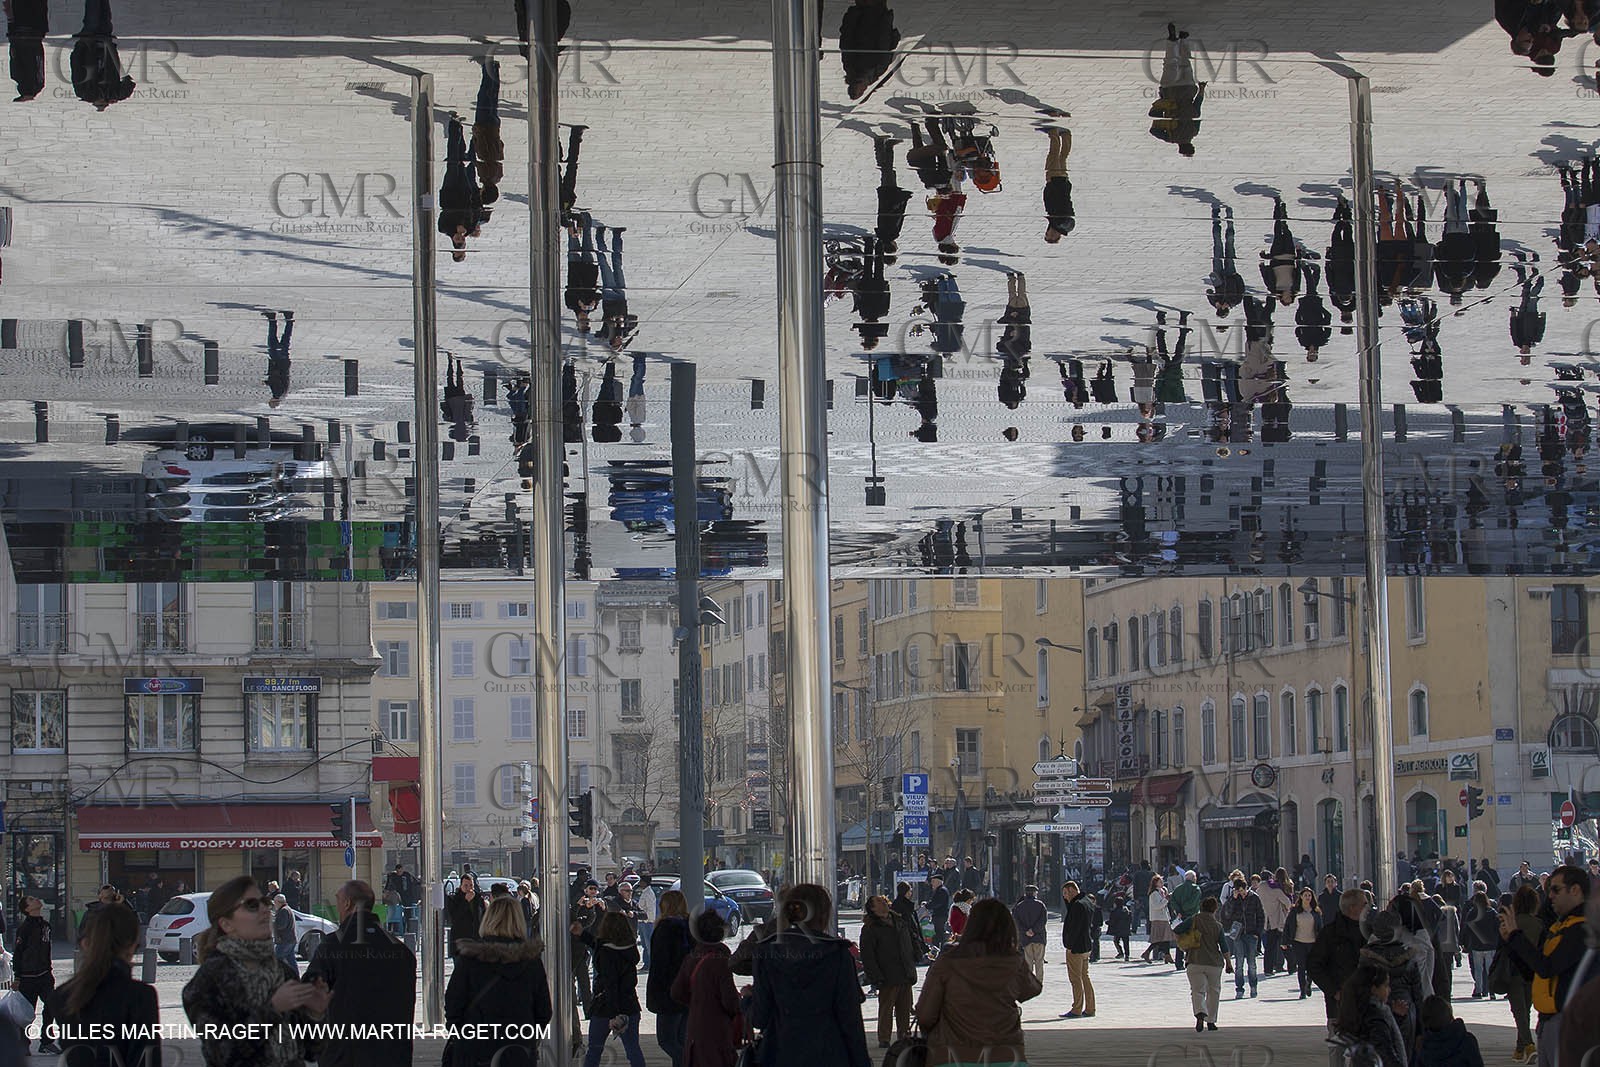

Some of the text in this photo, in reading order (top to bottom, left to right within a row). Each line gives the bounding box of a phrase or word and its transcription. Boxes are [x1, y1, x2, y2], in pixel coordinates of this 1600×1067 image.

[1118, 686, 1129, 695] LE
[909, 776, 922, 793] P
[90, 841, 170, 849] JUS DE FRUITS NATURELS
[294, 840, 372, 848] JUS DE FRUITS NARELS
